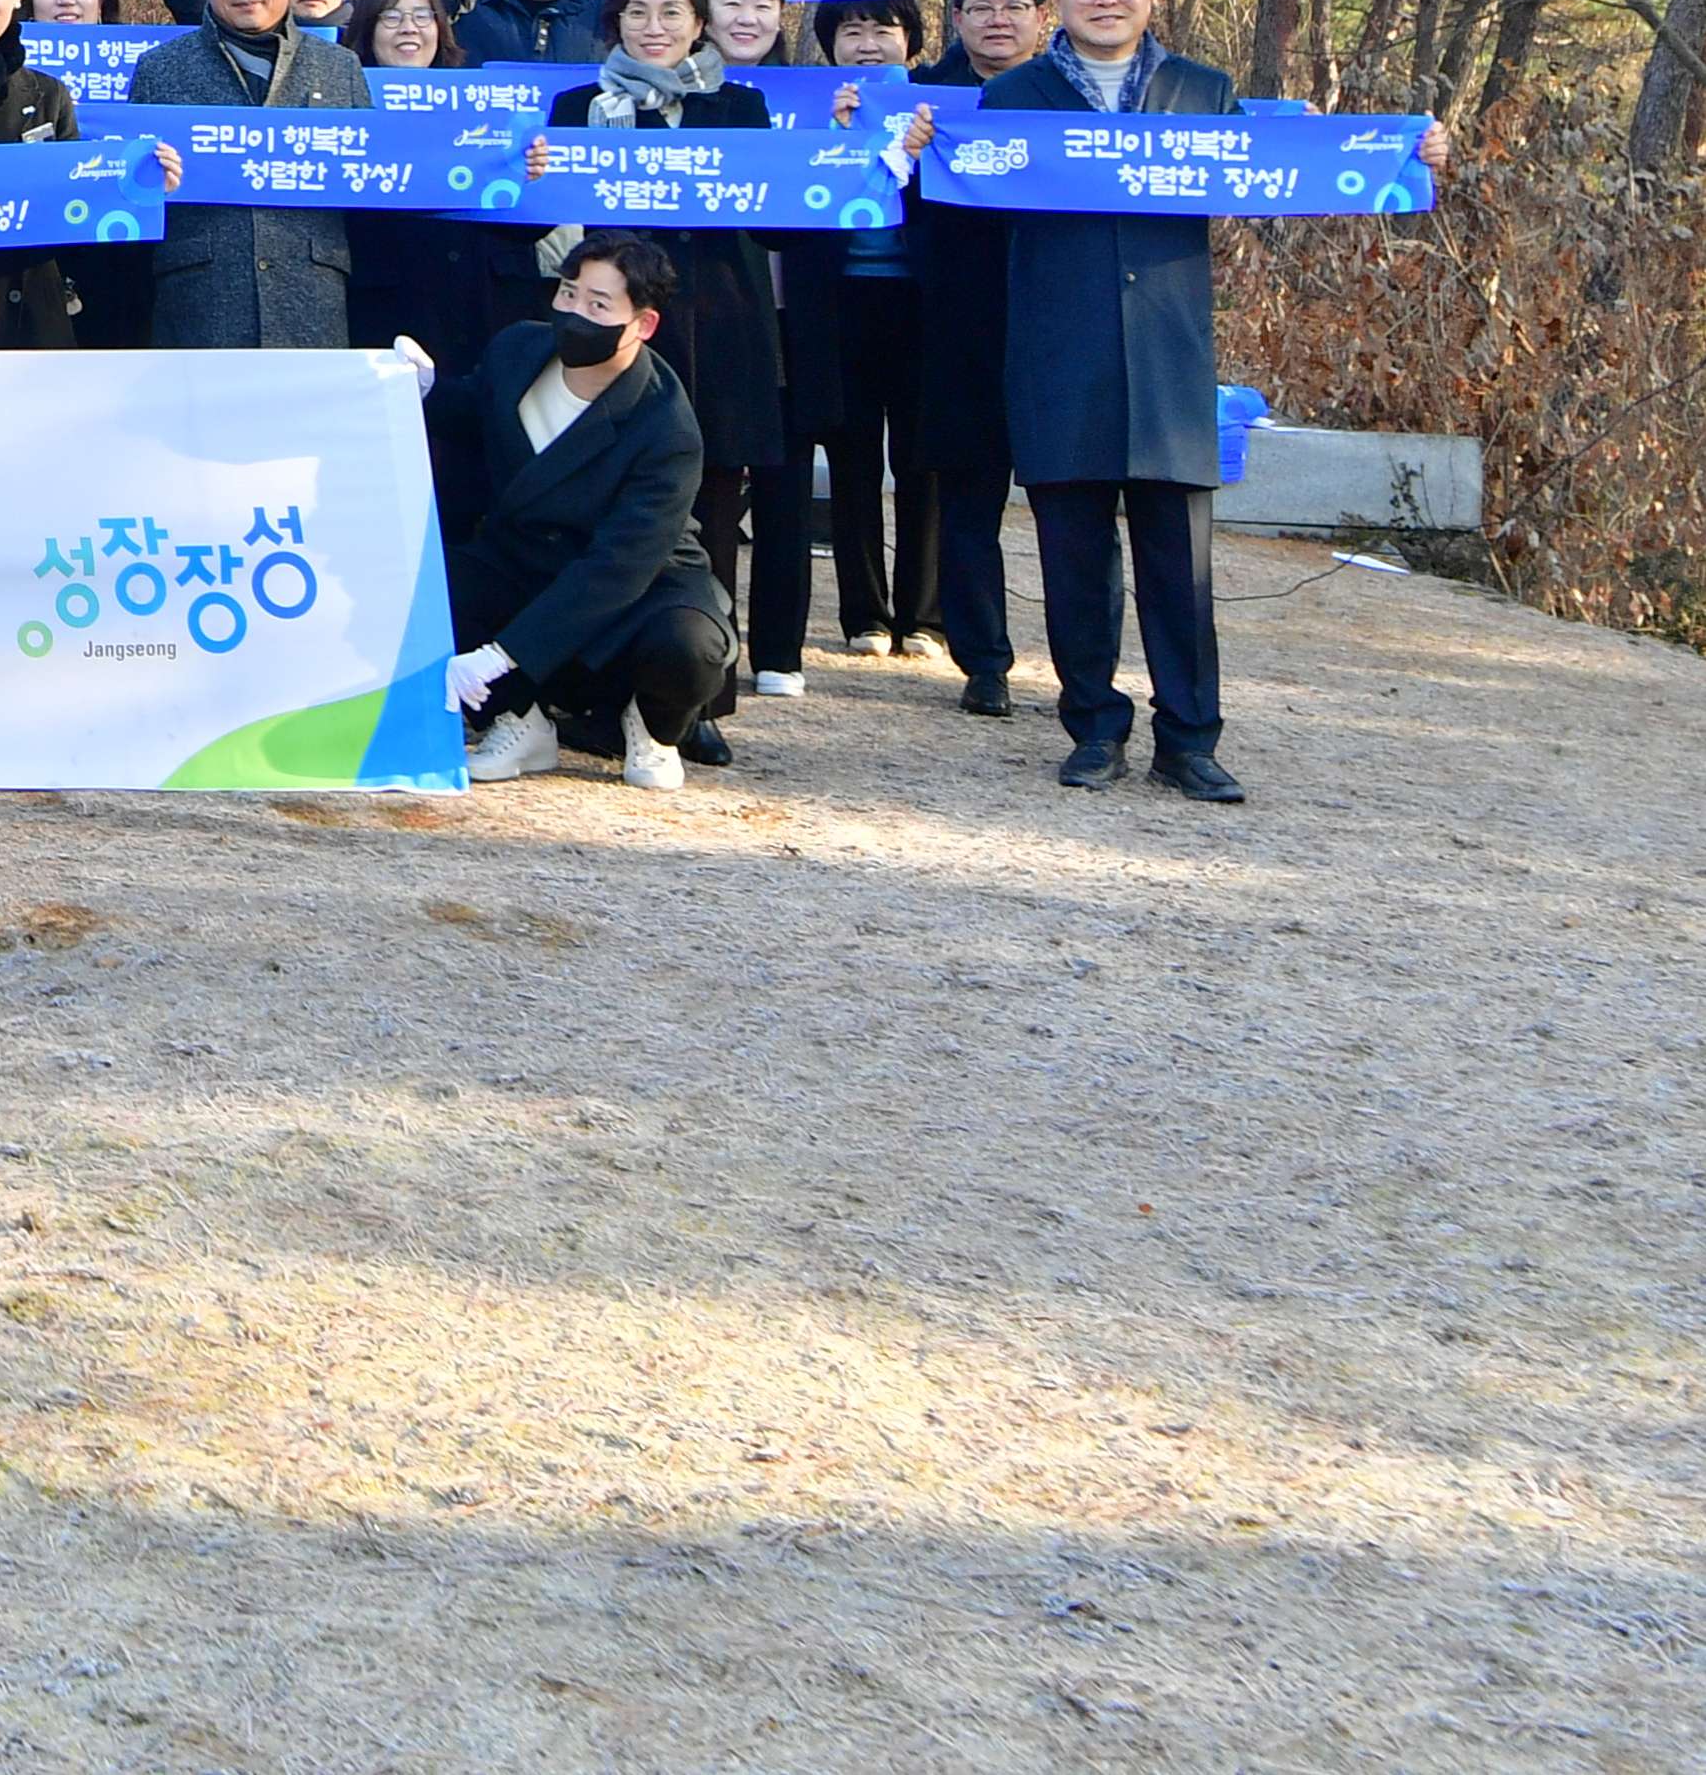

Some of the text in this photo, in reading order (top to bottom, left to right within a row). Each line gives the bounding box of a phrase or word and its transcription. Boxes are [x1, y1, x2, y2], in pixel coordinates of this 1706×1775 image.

[20, 39, 90, 66] 군민이
[382, 83, 542, 112] 군민이 행복한
[191, 125, 369, 157] 군민이 행복한
[1064, 128, 1253, 162] 군민이 행복한
[241, 160, 413, 192] 청렴한 장성!
[545, 145, 724, 177] 군민이 행복한
[594, 180, 768, 212] 청렴한 장성!
[1118, 165, 1299, 199] 청렴한 장성!
[33, 506, 317, 654] 성장장성
[84, 640, 177, 660] Jangseong
